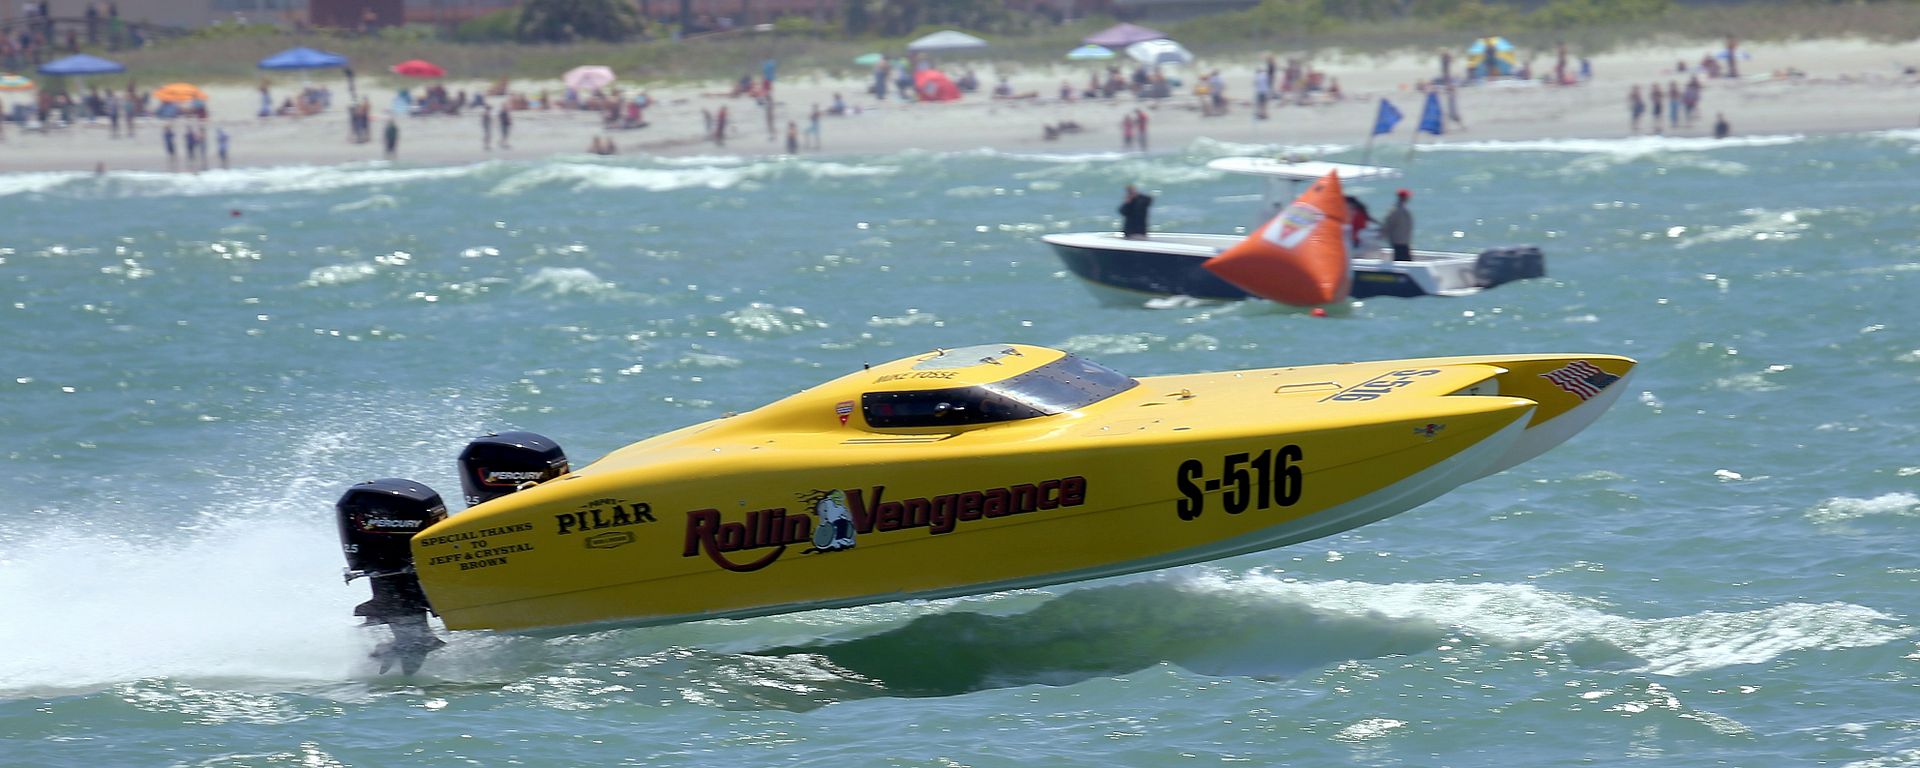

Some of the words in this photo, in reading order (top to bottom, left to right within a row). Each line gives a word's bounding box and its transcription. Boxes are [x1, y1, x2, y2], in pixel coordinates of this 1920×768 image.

[488, 471, 544, 480] MERCURY
[1176, 444, 1304, 521] S-516
[366, 519, 423, 529] MERCURY
[555, 502, 658, 535] PILAR
[683, 507, 811, 573] Rollin
[844, 475, 1087, 535] Vengeance
[421, 532, 478, 547] SPECIAL
[479, 522, 533, 538] THANKS
[470, 540, 487, 549] TO
[429, 553, 463, 566] JEFF
[464, 552, 473, 560] &
[474, 543, 534, 558] CRYSTAL
[460, 557, 508, 571] BROWN
